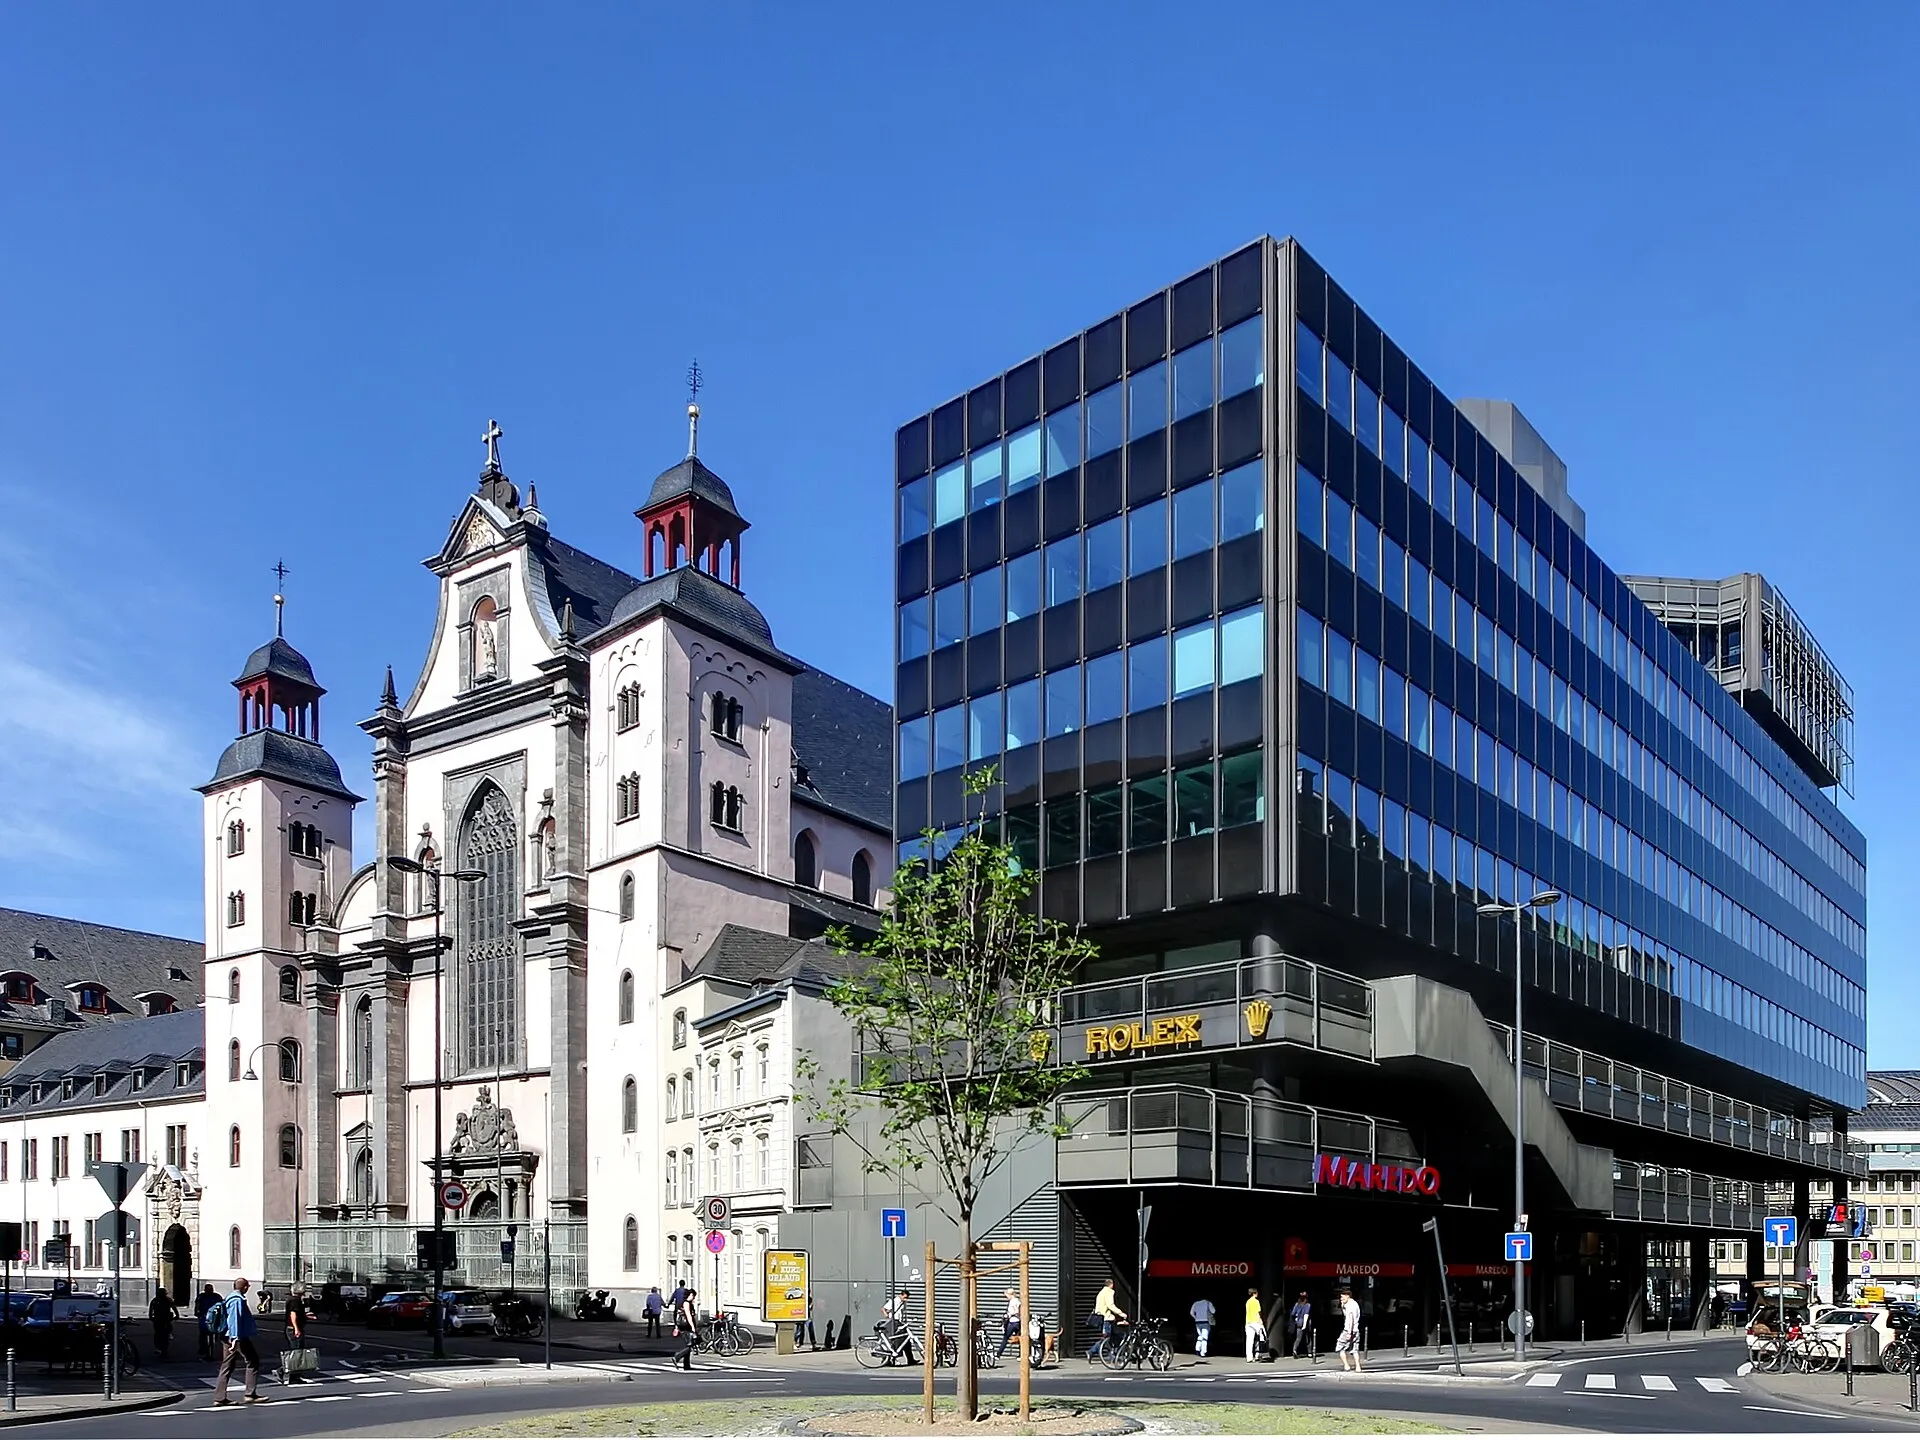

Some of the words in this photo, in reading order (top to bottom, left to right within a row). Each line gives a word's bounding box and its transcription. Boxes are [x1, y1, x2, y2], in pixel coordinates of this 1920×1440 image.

[1086, 1014, 1200, 1053] ROLEX
[1313, 1153, 1440, 1195] MAREDO
[713, 1204, 723, 1215] 30
[1191, 1262, 1249, 1275] MAREDO
[1336, 1264, 1380, 1274] MAREDO
[1476, 1265, 1508, 1274] MAREDO
